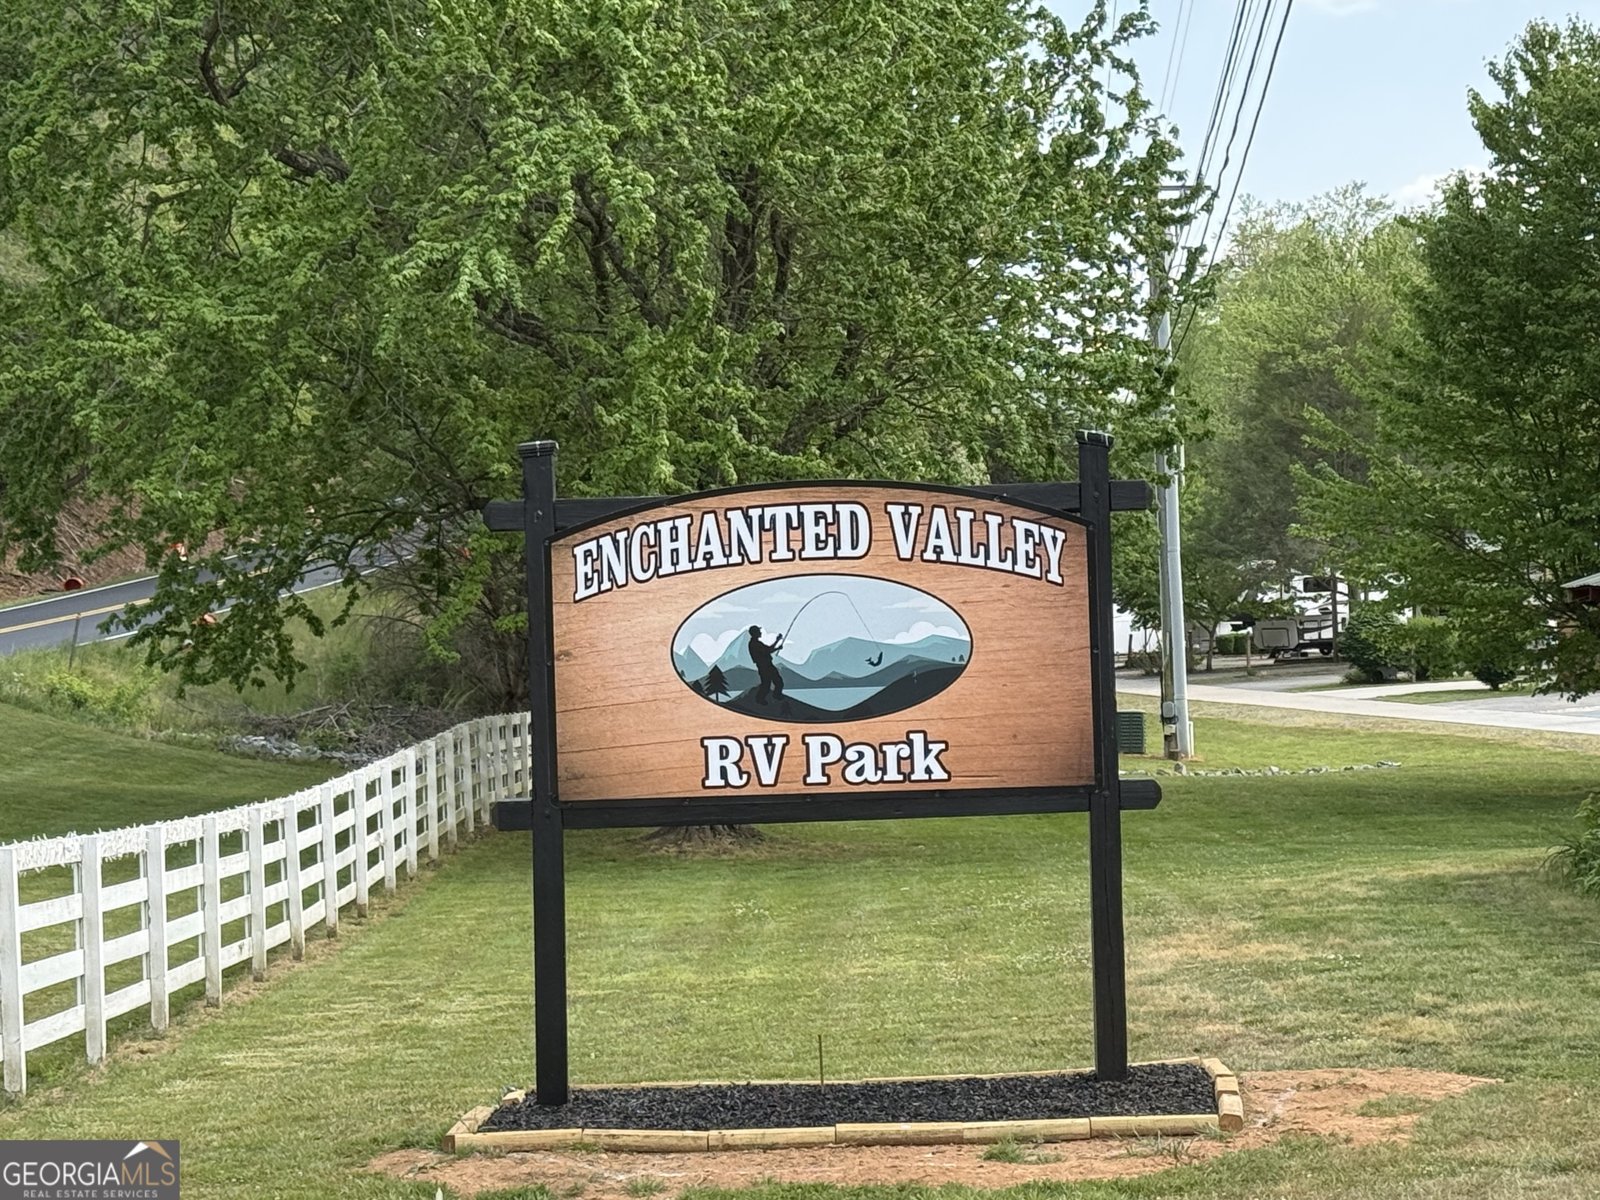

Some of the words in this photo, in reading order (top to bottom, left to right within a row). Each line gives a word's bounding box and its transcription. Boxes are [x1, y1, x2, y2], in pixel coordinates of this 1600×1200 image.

[573, 502, 872, 602] ENCHANTED
[886, 502, 1067, 586] VALLEY
[701, 735, 788, 788] RV
[803, 730, 951, 786] Park
